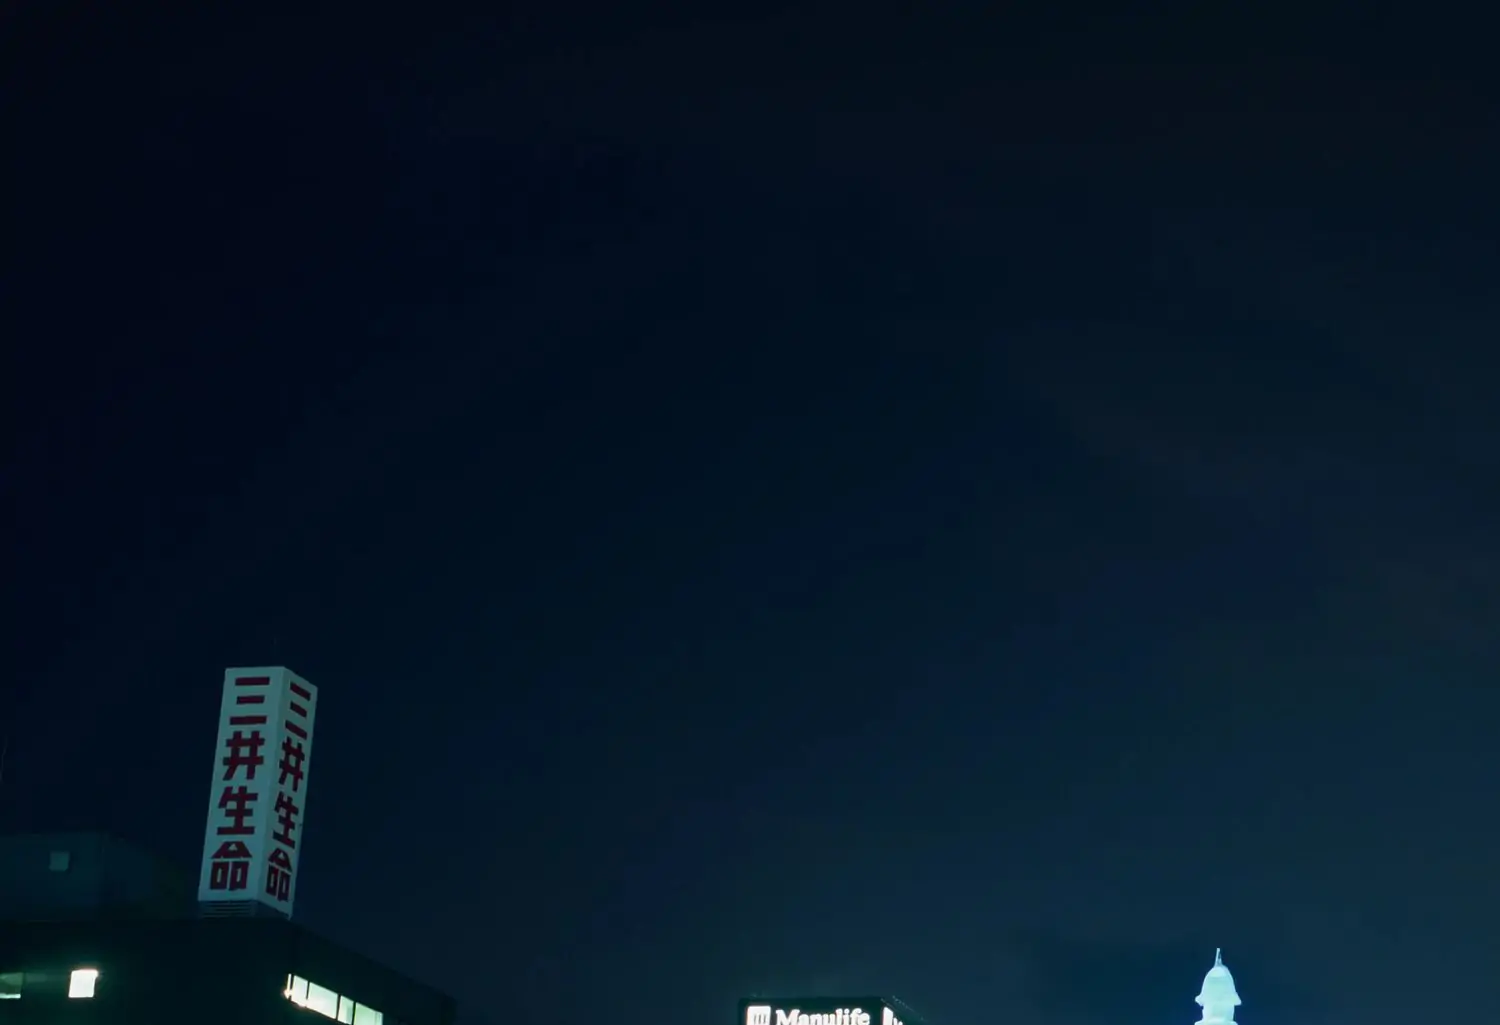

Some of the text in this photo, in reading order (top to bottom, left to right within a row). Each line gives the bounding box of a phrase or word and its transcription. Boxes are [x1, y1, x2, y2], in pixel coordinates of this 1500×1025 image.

[210, 677, 270, 891] 三井生命
[266, 682, 311, 902] 三井生命
